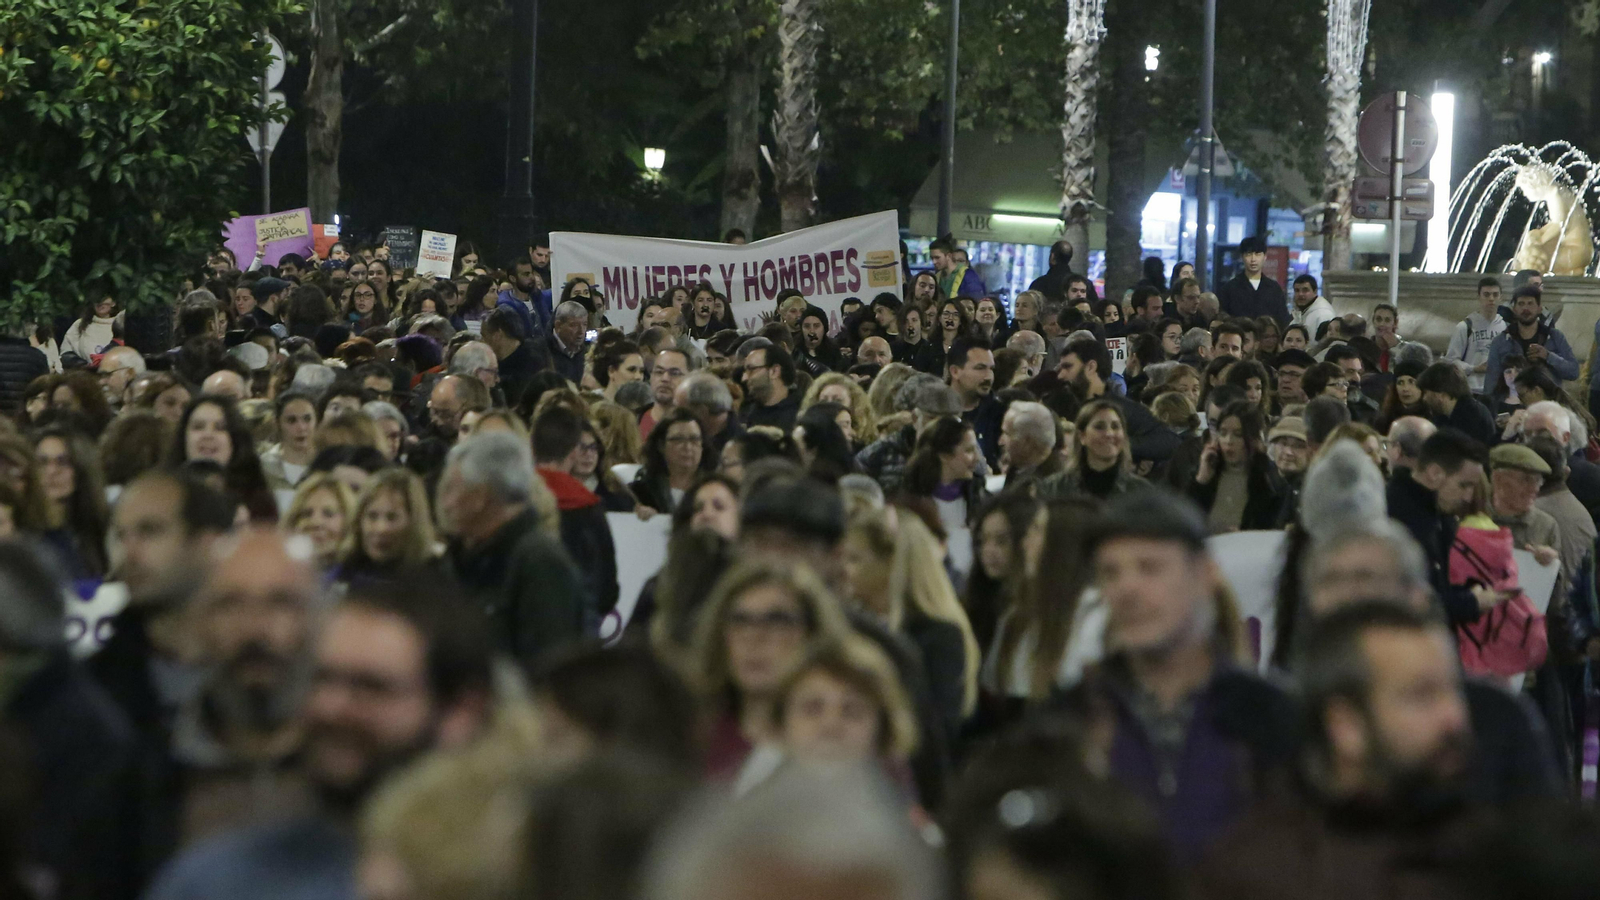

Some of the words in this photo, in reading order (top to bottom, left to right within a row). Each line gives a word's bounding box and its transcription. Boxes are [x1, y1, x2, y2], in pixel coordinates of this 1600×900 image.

[603, 264, 712, 310] MUJERES
[719, 263, 736, 303] Y
[744, 247, 861, 302] HOMBRES
